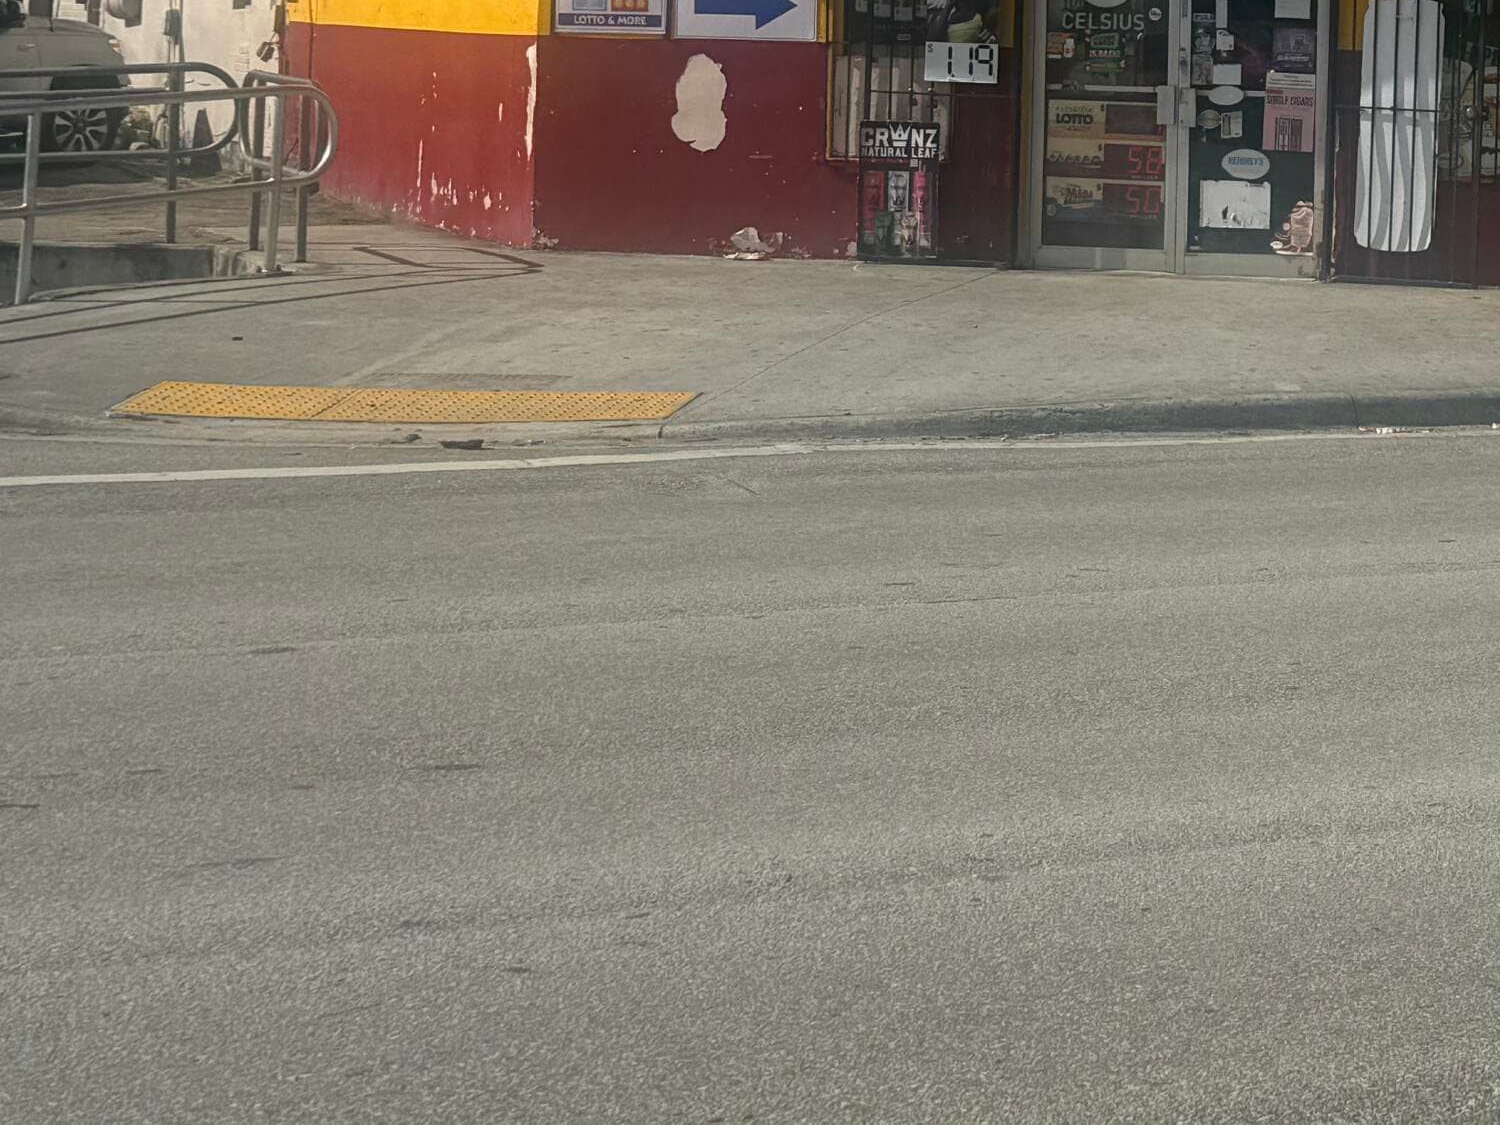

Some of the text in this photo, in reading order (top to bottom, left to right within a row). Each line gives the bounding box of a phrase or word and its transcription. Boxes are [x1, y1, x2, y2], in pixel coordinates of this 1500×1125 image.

[573, 15, 647, 26] LOTTO & MORE
[1061, 11, 1145, 30] CELSIUS
[1056, 114, 1095, 125] LOTTO
[861, 147, 937, 159] NATURAL LEAF
